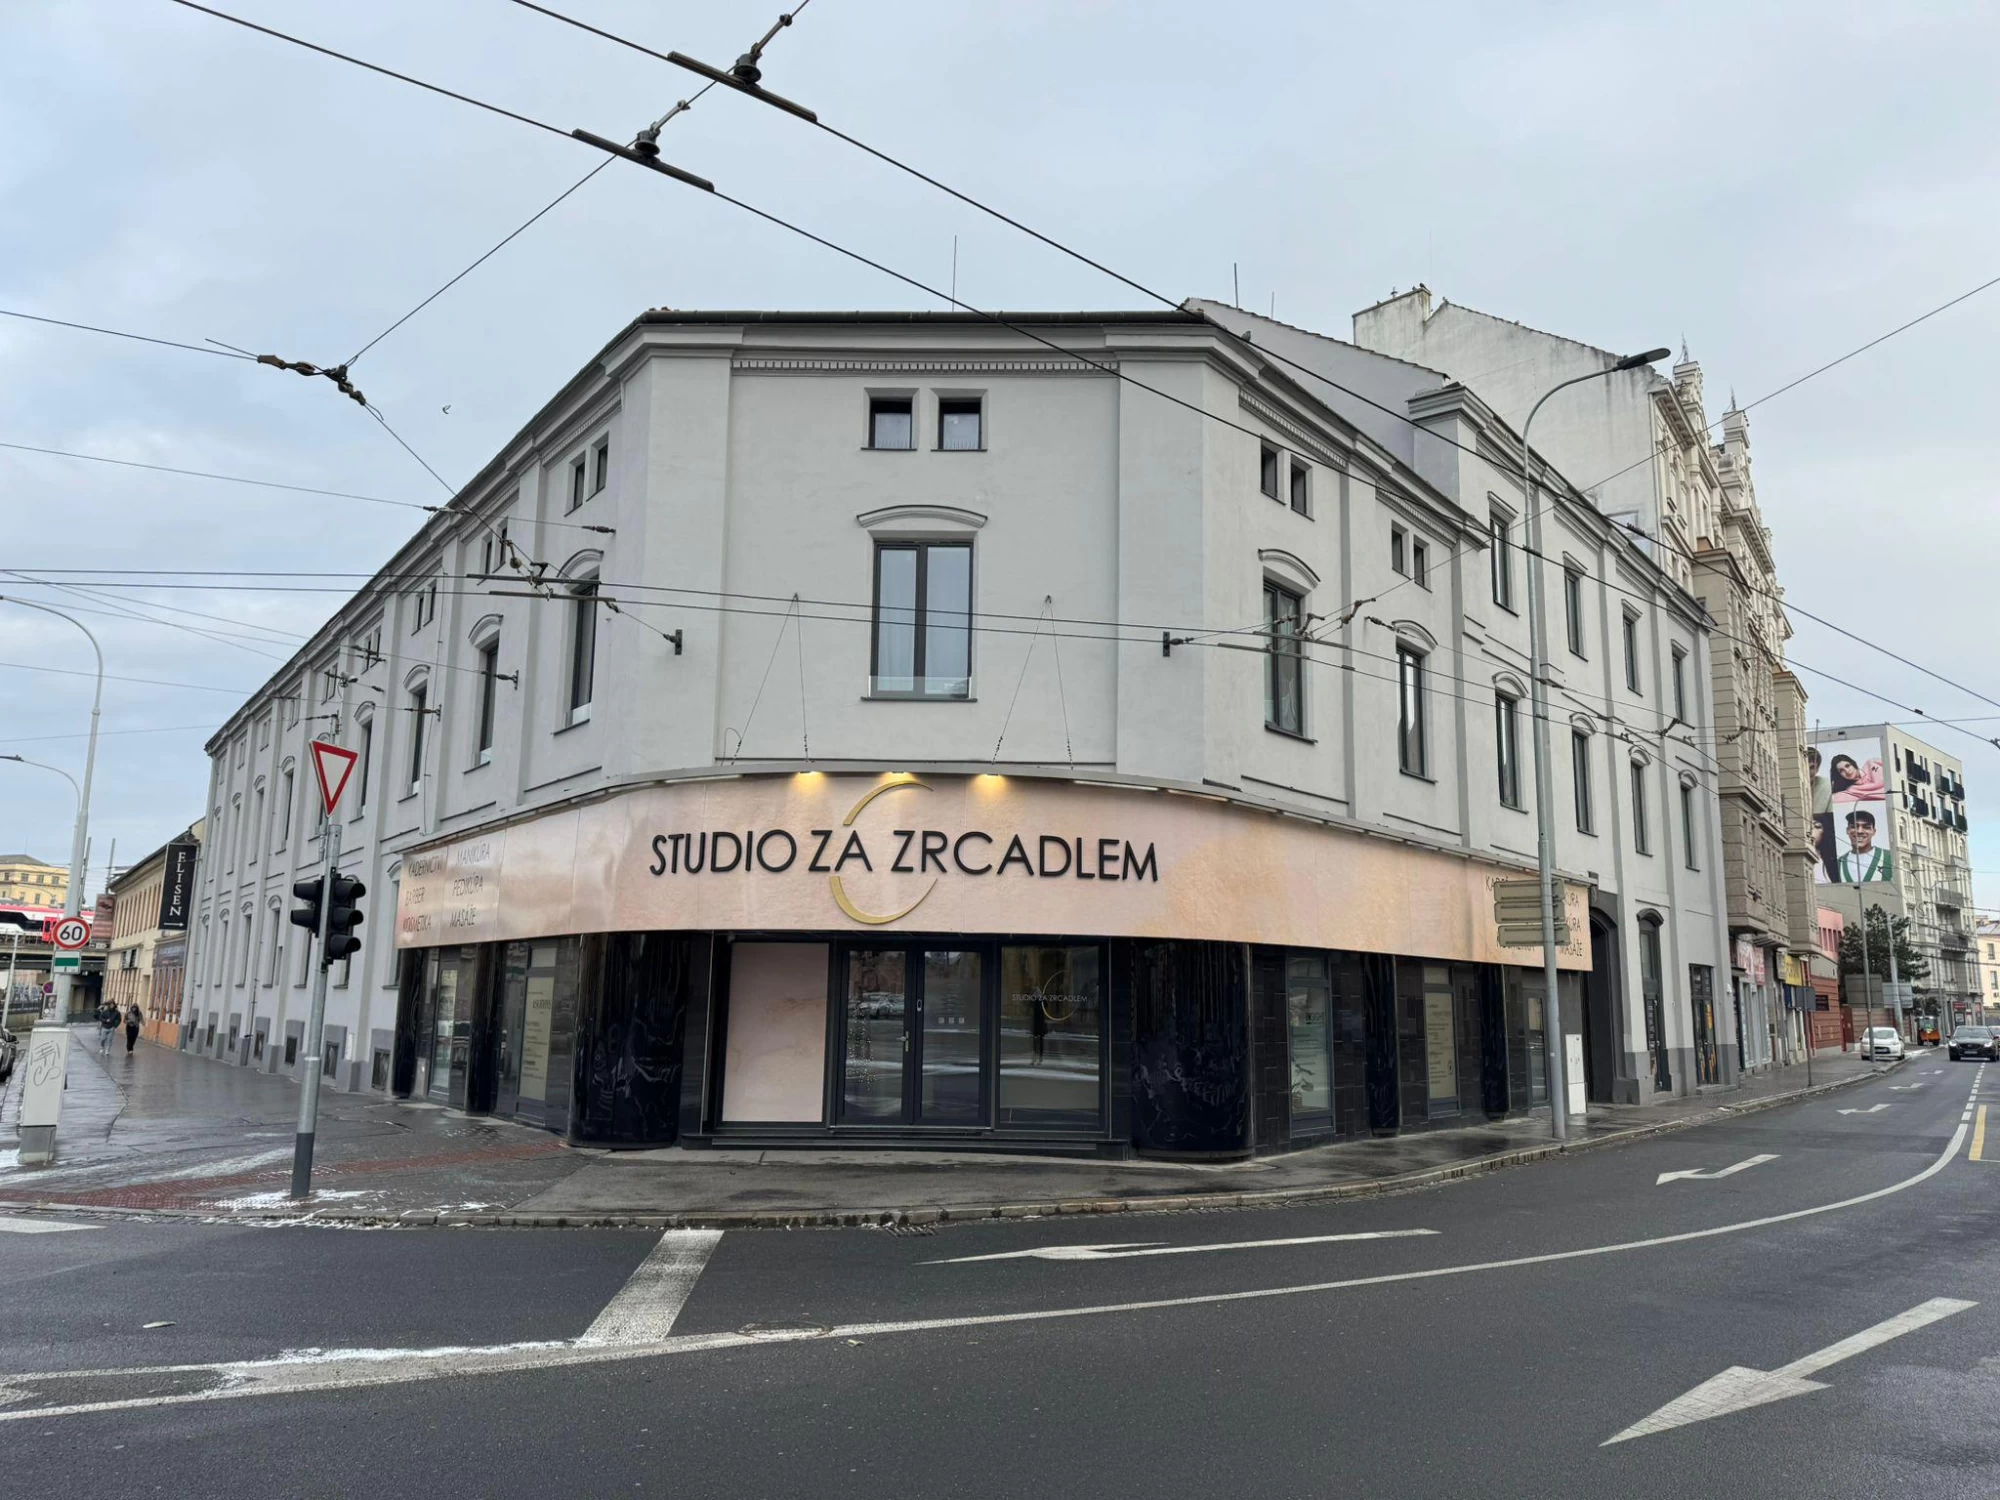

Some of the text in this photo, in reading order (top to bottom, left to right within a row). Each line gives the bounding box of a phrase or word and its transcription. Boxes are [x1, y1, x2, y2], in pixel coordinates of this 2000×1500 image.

[649, 829, 1158, 882] STUDIO ZA ZRCADLEM
[169, 851, 187, 917] ELISEN
[60, 925, 83, 941] 60
[1011, 993, 1037, 1002] STUDIO
[1049, 994, 1088, 1002] ZRCADLEM
